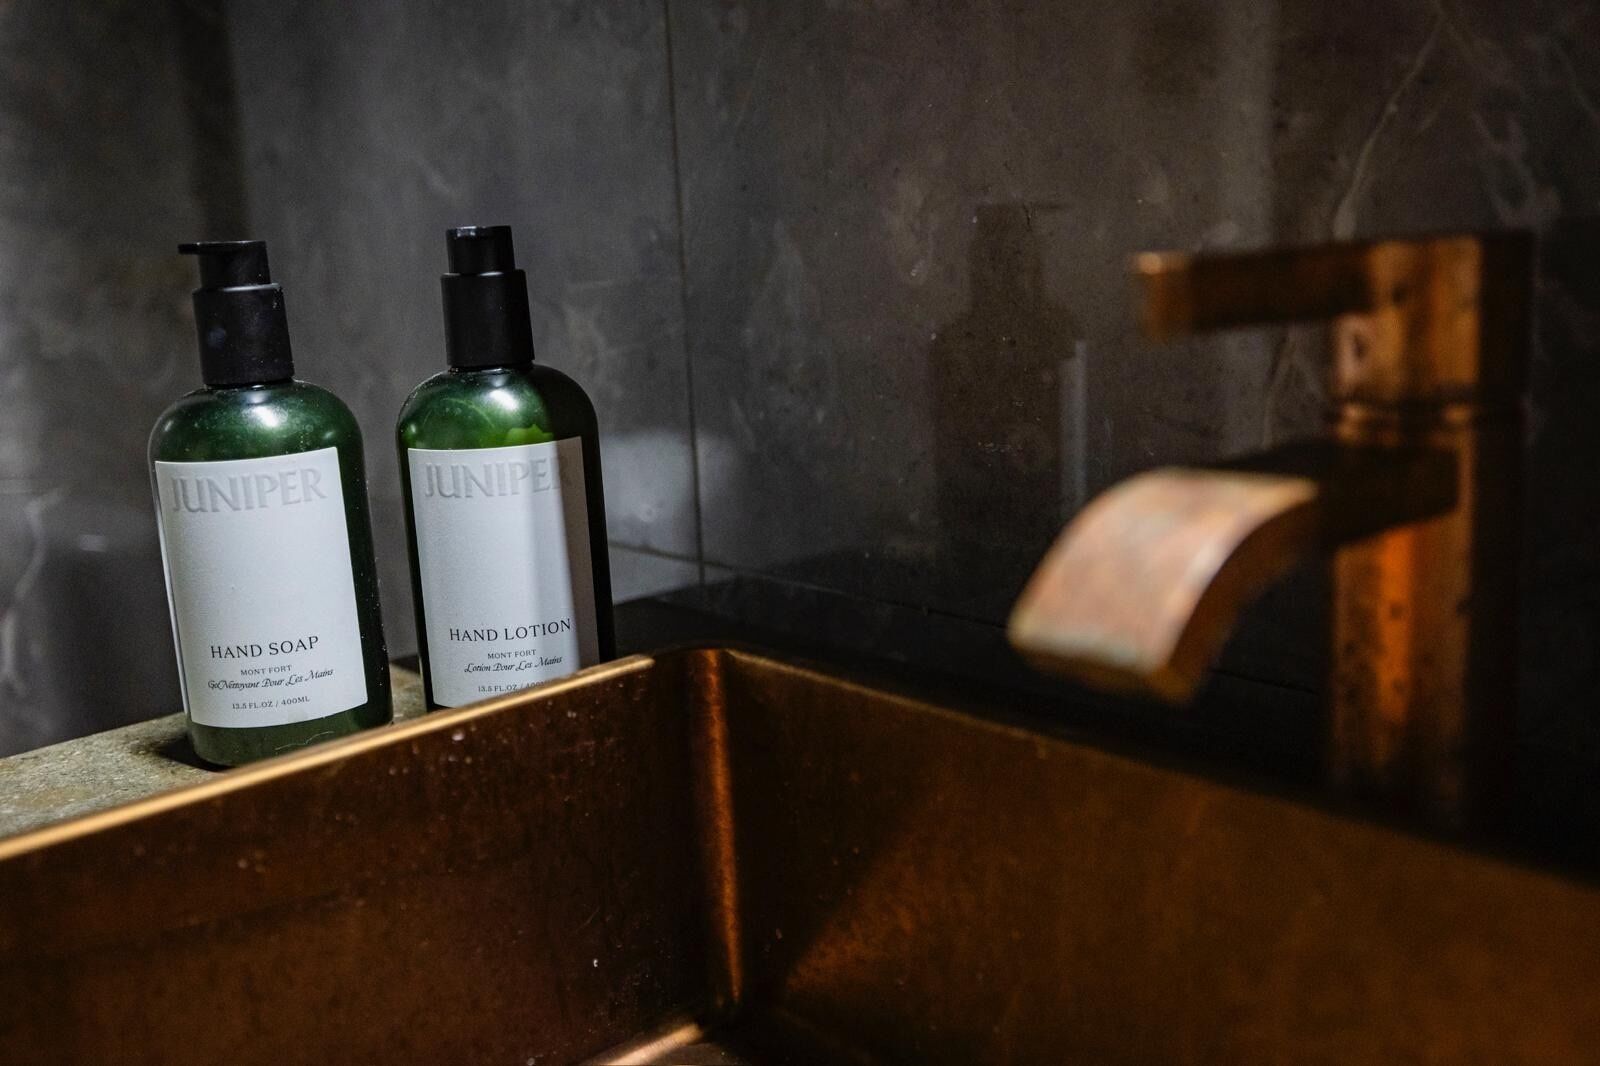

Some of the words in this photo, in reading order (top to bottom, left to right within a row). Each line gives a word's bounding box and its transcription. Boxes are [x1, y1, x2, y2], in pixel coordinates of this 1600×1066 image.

[170, 467, 328, 513] JUNIPER
[449, 628, 498, 642] HAND
[504, 618, 571, 641] LOTION
[210, 644, 262, 659] HAND
[268, 635, 319, 656] SOAP
[514, 649, 537, 657] FORT
[240, 668, 267, 676] MONT
[268, 664, 293, 673] FORT
[464, 662, 491, 673] Lotion
[492, 663, 515, 672] Pour
[515, 660, 532, 671] Les
[534, 655, 563, 668] Mains
[261, 677, 285, 689] Pour
[285, 674, 303, 686] Les
[305, 669, 334, 681] Mains
[280, 695, 310, 705] 400ML
